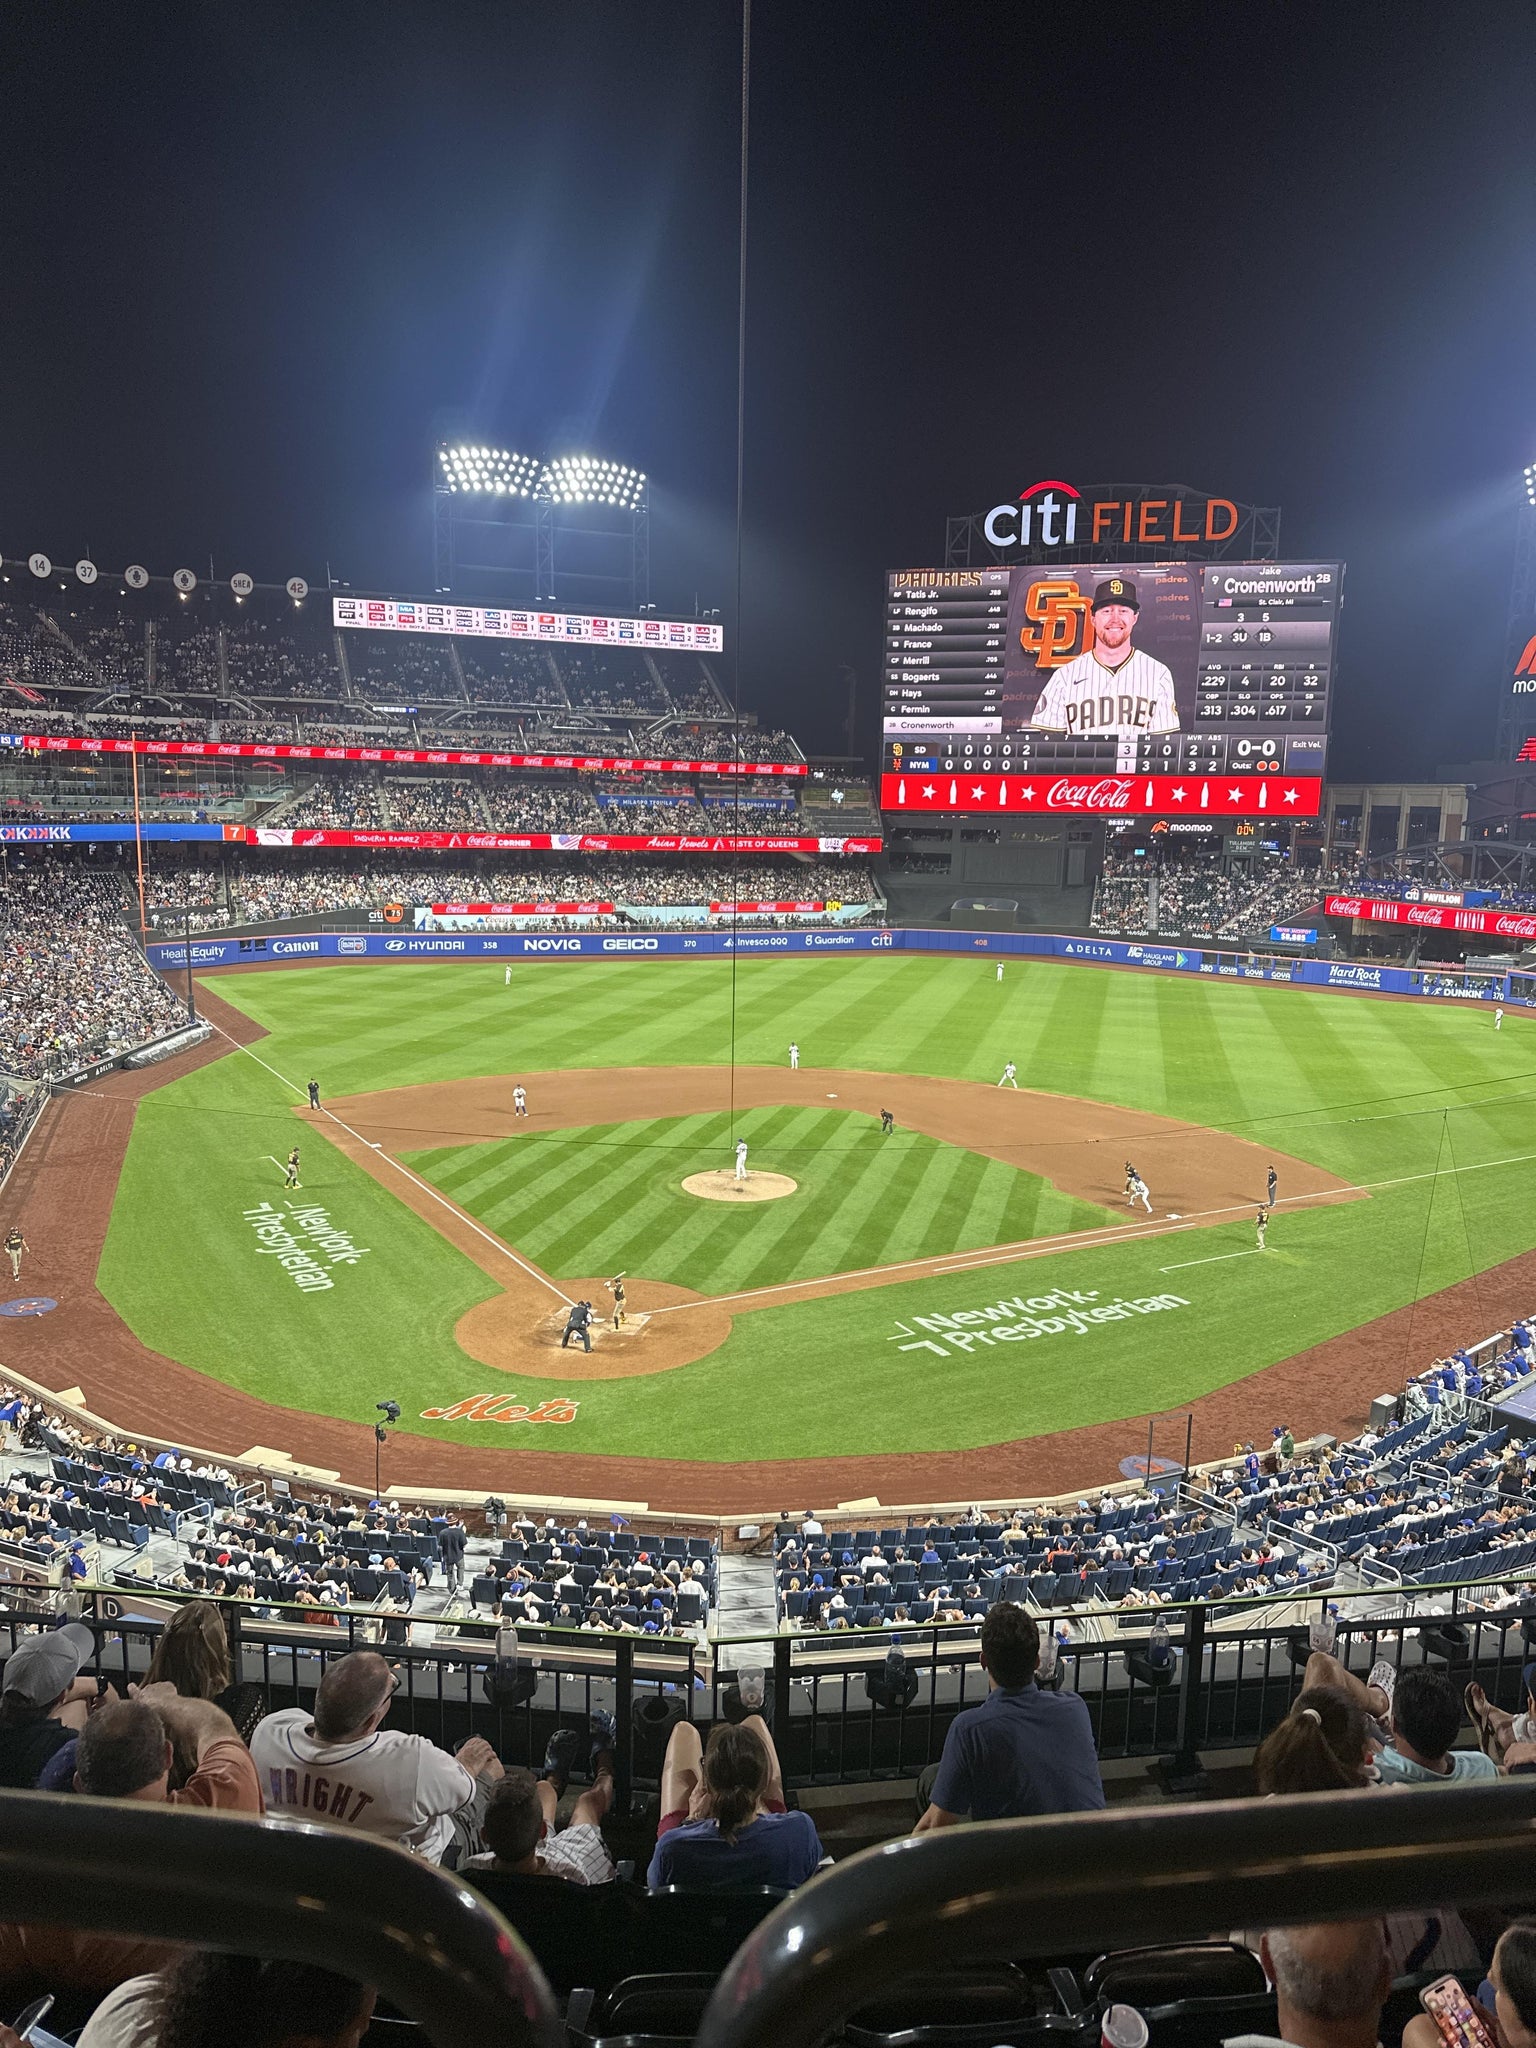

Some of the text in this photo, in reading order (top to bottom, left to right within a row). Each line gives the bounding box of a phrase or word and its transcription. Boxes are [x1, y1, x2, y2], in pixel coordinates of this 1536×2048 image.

[983, 492, 1239, 547] citi FIELD
[34, 560, 46, 572] 14
[80, 566, 93, 578] 37
[1260, 567, 1282, 576] Jake
[233, 578, 250, 589] SHEA
[1155, 575, 1188, 585] padres
[1212, 576, 1219, 585] 9
[1316, 574, 1331, 584] 2B
[289, 583, 304, 594] 42
[1224, 576, 1316, 594] Cronenworth
[906, 590, 939, 598] Tatis Jr.
[1156, 594, 1190, 603] padres
[904, 606, 938, 617] Rengifo
[1237, 612, 1270, 622] 3 5
[904, 623, 943, 632] Machado
[1206, 632, 1271, 643] 1-2 3U 1B
[903, 640, 932, 648] France
[903, 656, 930, 665] Merrill
[902, 673, 940, 683] Bogaerts
[1201, 676, 1318, 686] .229 4 20 32
[901, 689, 922, 699] Hays
[900, 705, 931, 714] Fermin
[1200, 706, 1312, 716] .313 .304 .617 7
[914, 745, 1198, 755] SD 0 0 0 2 3 7 0 2
[1238, 740, 1276, 756] 0-0
[944, 760, 953, 770] 0
[964, 760, 972, 770] 0
[982, 760, 991, 770] 0
[1002, 760, 1010, 770] 0
[1142, 761, 1150, 771] 3
[1188, 761, 1196, 772] 3
[1208, 761, 1217, 772] 2
[1047, 778, 1136, 808] Coca-Cola
[1170, 823, 1213, 832] moomoo
[1236, 826, 1254, 835] 0:04
[230, 828, 240, 838] 7
[388, 835, 420, 844] RAMIREZ
[498, 839, 531, 847] CORNER
[646, 836, 678, 848] Asian
[678, 837, 709, 850] Jewels
[728, 840, 753, 848] TASTE
[755, 840, 765, 848] OF
[767, 840, 799, 848] QUEENS
[1423, 893, 1460, 904] PAVILION
[1330, 898, 1536, 936] Coca-Cola Coca-Cola Coca-Cola
[524, 940, 581, 950] NOVIG
[603, 938, 658, 950] GEICO
[684, 940, 697, 948] 370
[737, 938, 788, 946] Invesco QQQ
[814, 935, 855, 945] Guardian
[872, 934, 893, 946] citi
[272, 942, 319, 954] Canon
[409, 941, 464, 950] HYUNDAI
[1077, 944, 1112, 956] DELTA
[1142, 958, 1162, 966] GROUP
[1143, 952, 1174, 962] HAUGLAND
[1200, 964, 1213, 972] 380
[1244, 969, 1264, 977] GOYA
[1271, 971, 1290, 980] GOYA
[1329, 965, 1381, 982] Hard Rock
[1444, 988, 1484, 998] DUNKIN'
[1492, 992, 1504, 1000] 370
[244, 1213, 335, 1292] Presbyterian
[941, 1293, 1192, 1352] Presbyterian
[419, 1394, 581, 1424] Mets
[107, 1600, 118, 1617] D
[269, 1767, 374, 1823] WRIGHT
